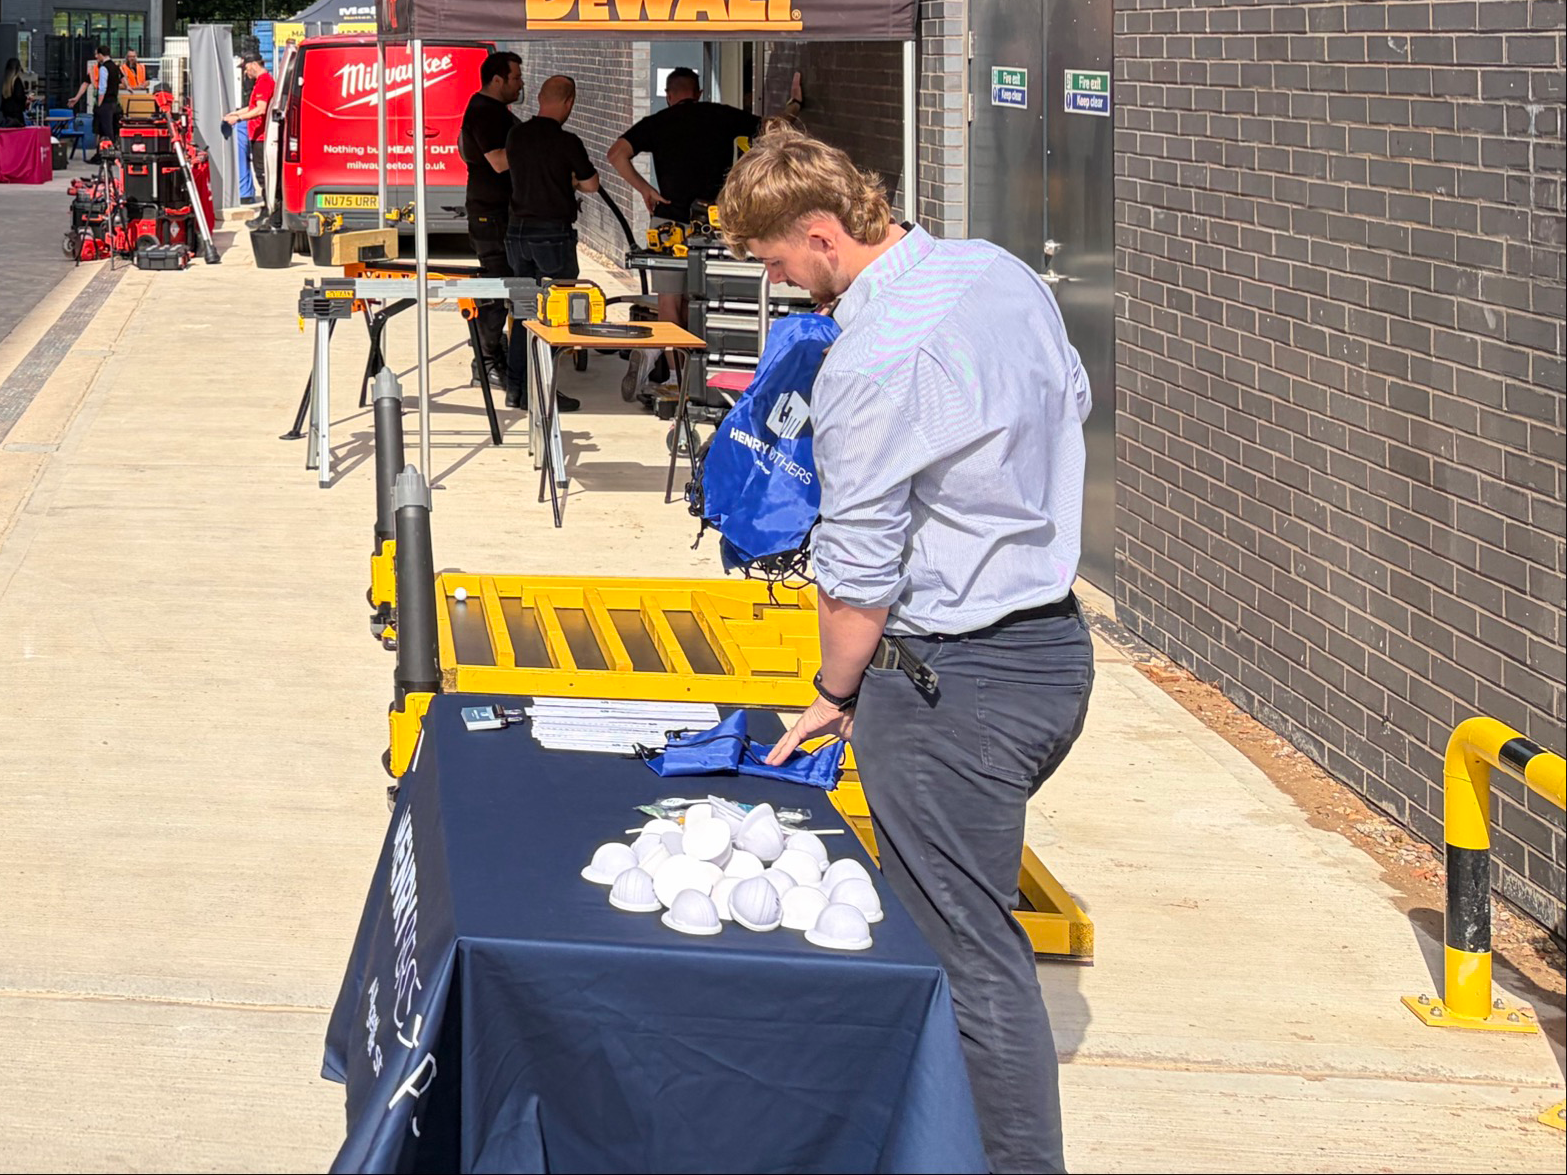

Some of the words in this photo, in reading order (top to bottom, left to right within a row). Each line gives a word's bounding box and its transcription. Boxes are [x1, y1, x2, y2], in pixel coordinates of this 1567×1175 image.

[1002, 73, 1012, 84] Fire
[1012, 73, 1021, 85] exit
[1078, 76, 1090, 89] Fire
[1090, 77, 1102, 90] exit
[1001, 90, 1012, 102] Keep
[1012, 90, 1023, 101] clear
[1076, 95, 1090, 109] Keep
[1090, 96, 1104, 108] clear
[323, 145, 364, 156] Nothing
[324, 196, 353, 207] NU75
[355, 196, 377, 207] URR
[729, 427, 770, 455] HENRY
